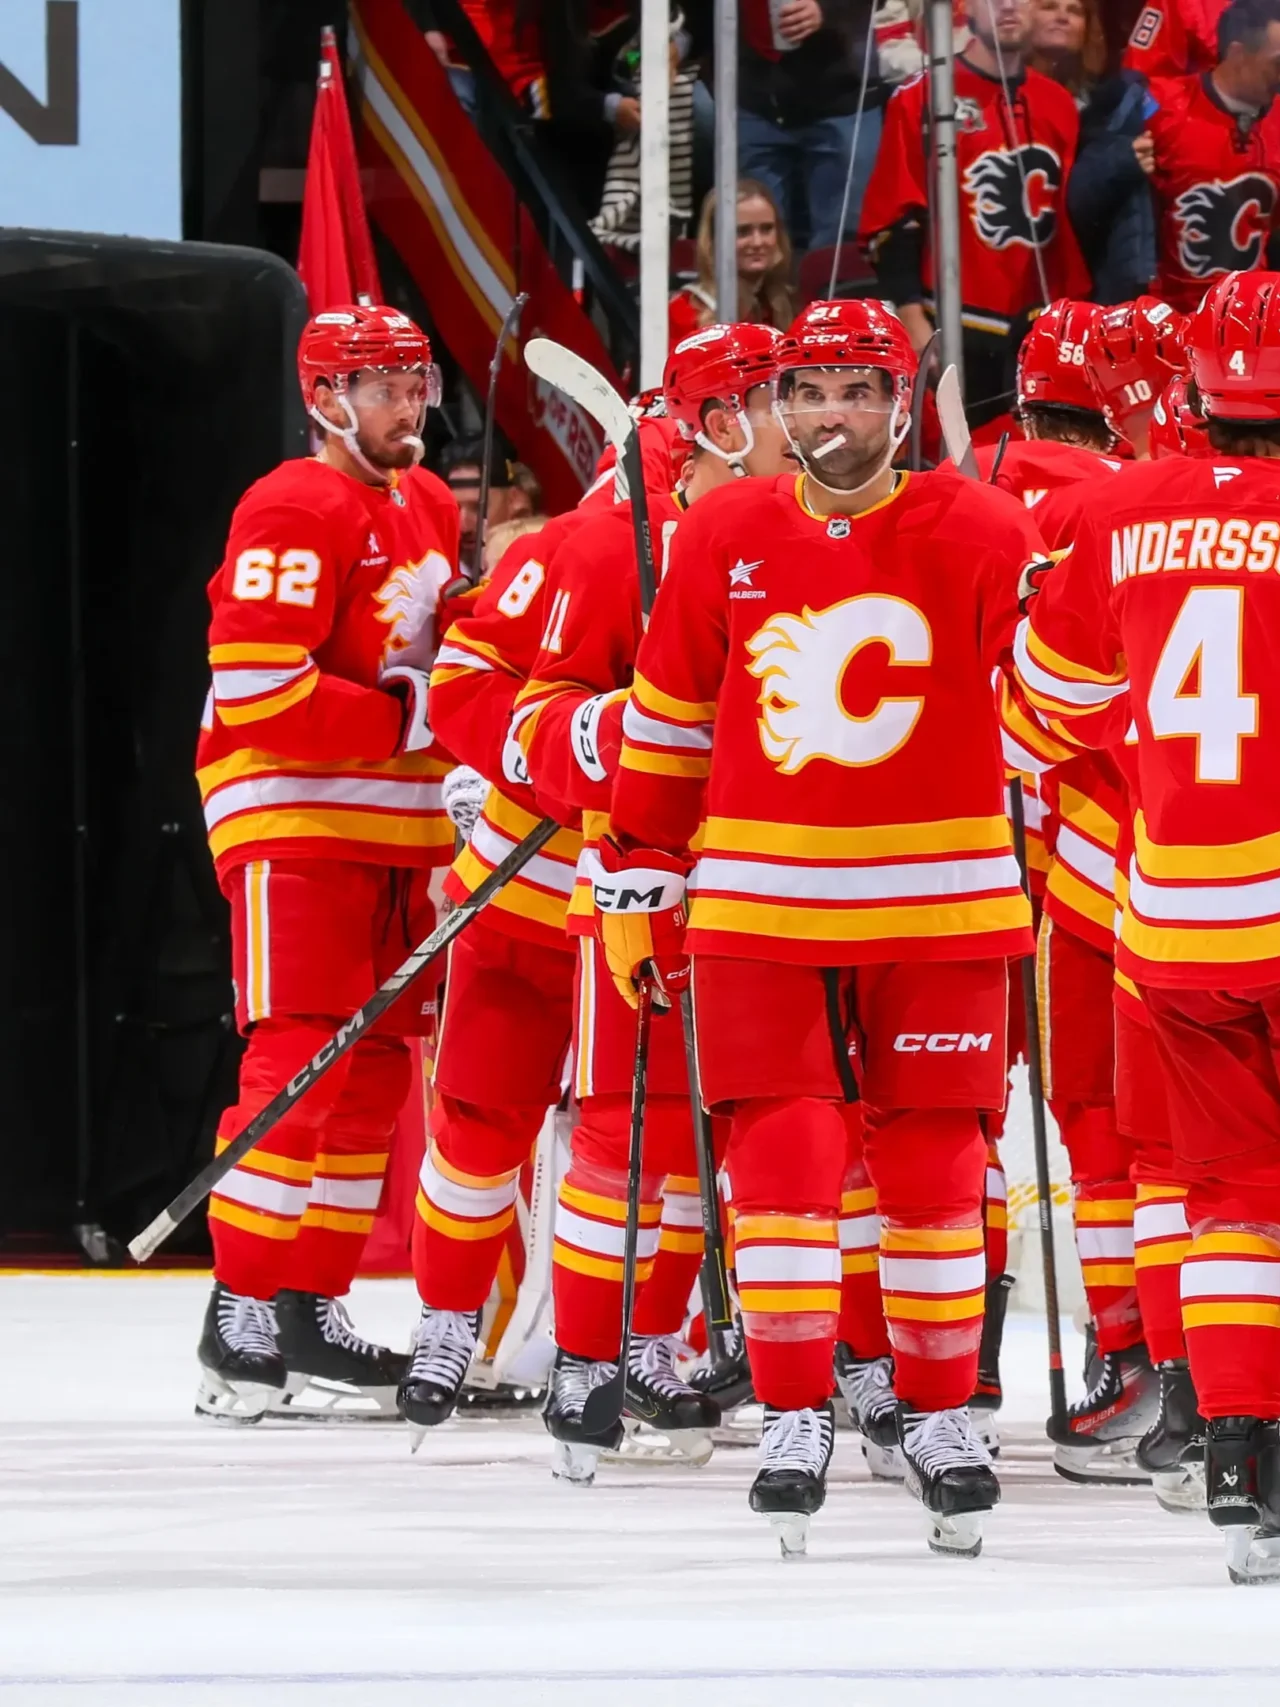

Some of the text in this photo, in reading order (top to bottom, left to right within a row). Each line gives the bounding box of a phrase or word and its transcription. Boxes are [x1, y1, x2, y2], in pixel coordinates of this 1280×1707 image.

[802, 333, 849, 345] CCM
[1229, 349, 1246, 376] 4
[1123, 379, 1153, 406] 10
[232, 547, 321, 609] 62
[1147, 584, 1260, 785] 4
[594, 885, 666, 910] CM
[287, 1009, 364, 1097] CCM
[893, 1033, 993, 1052] CCM
